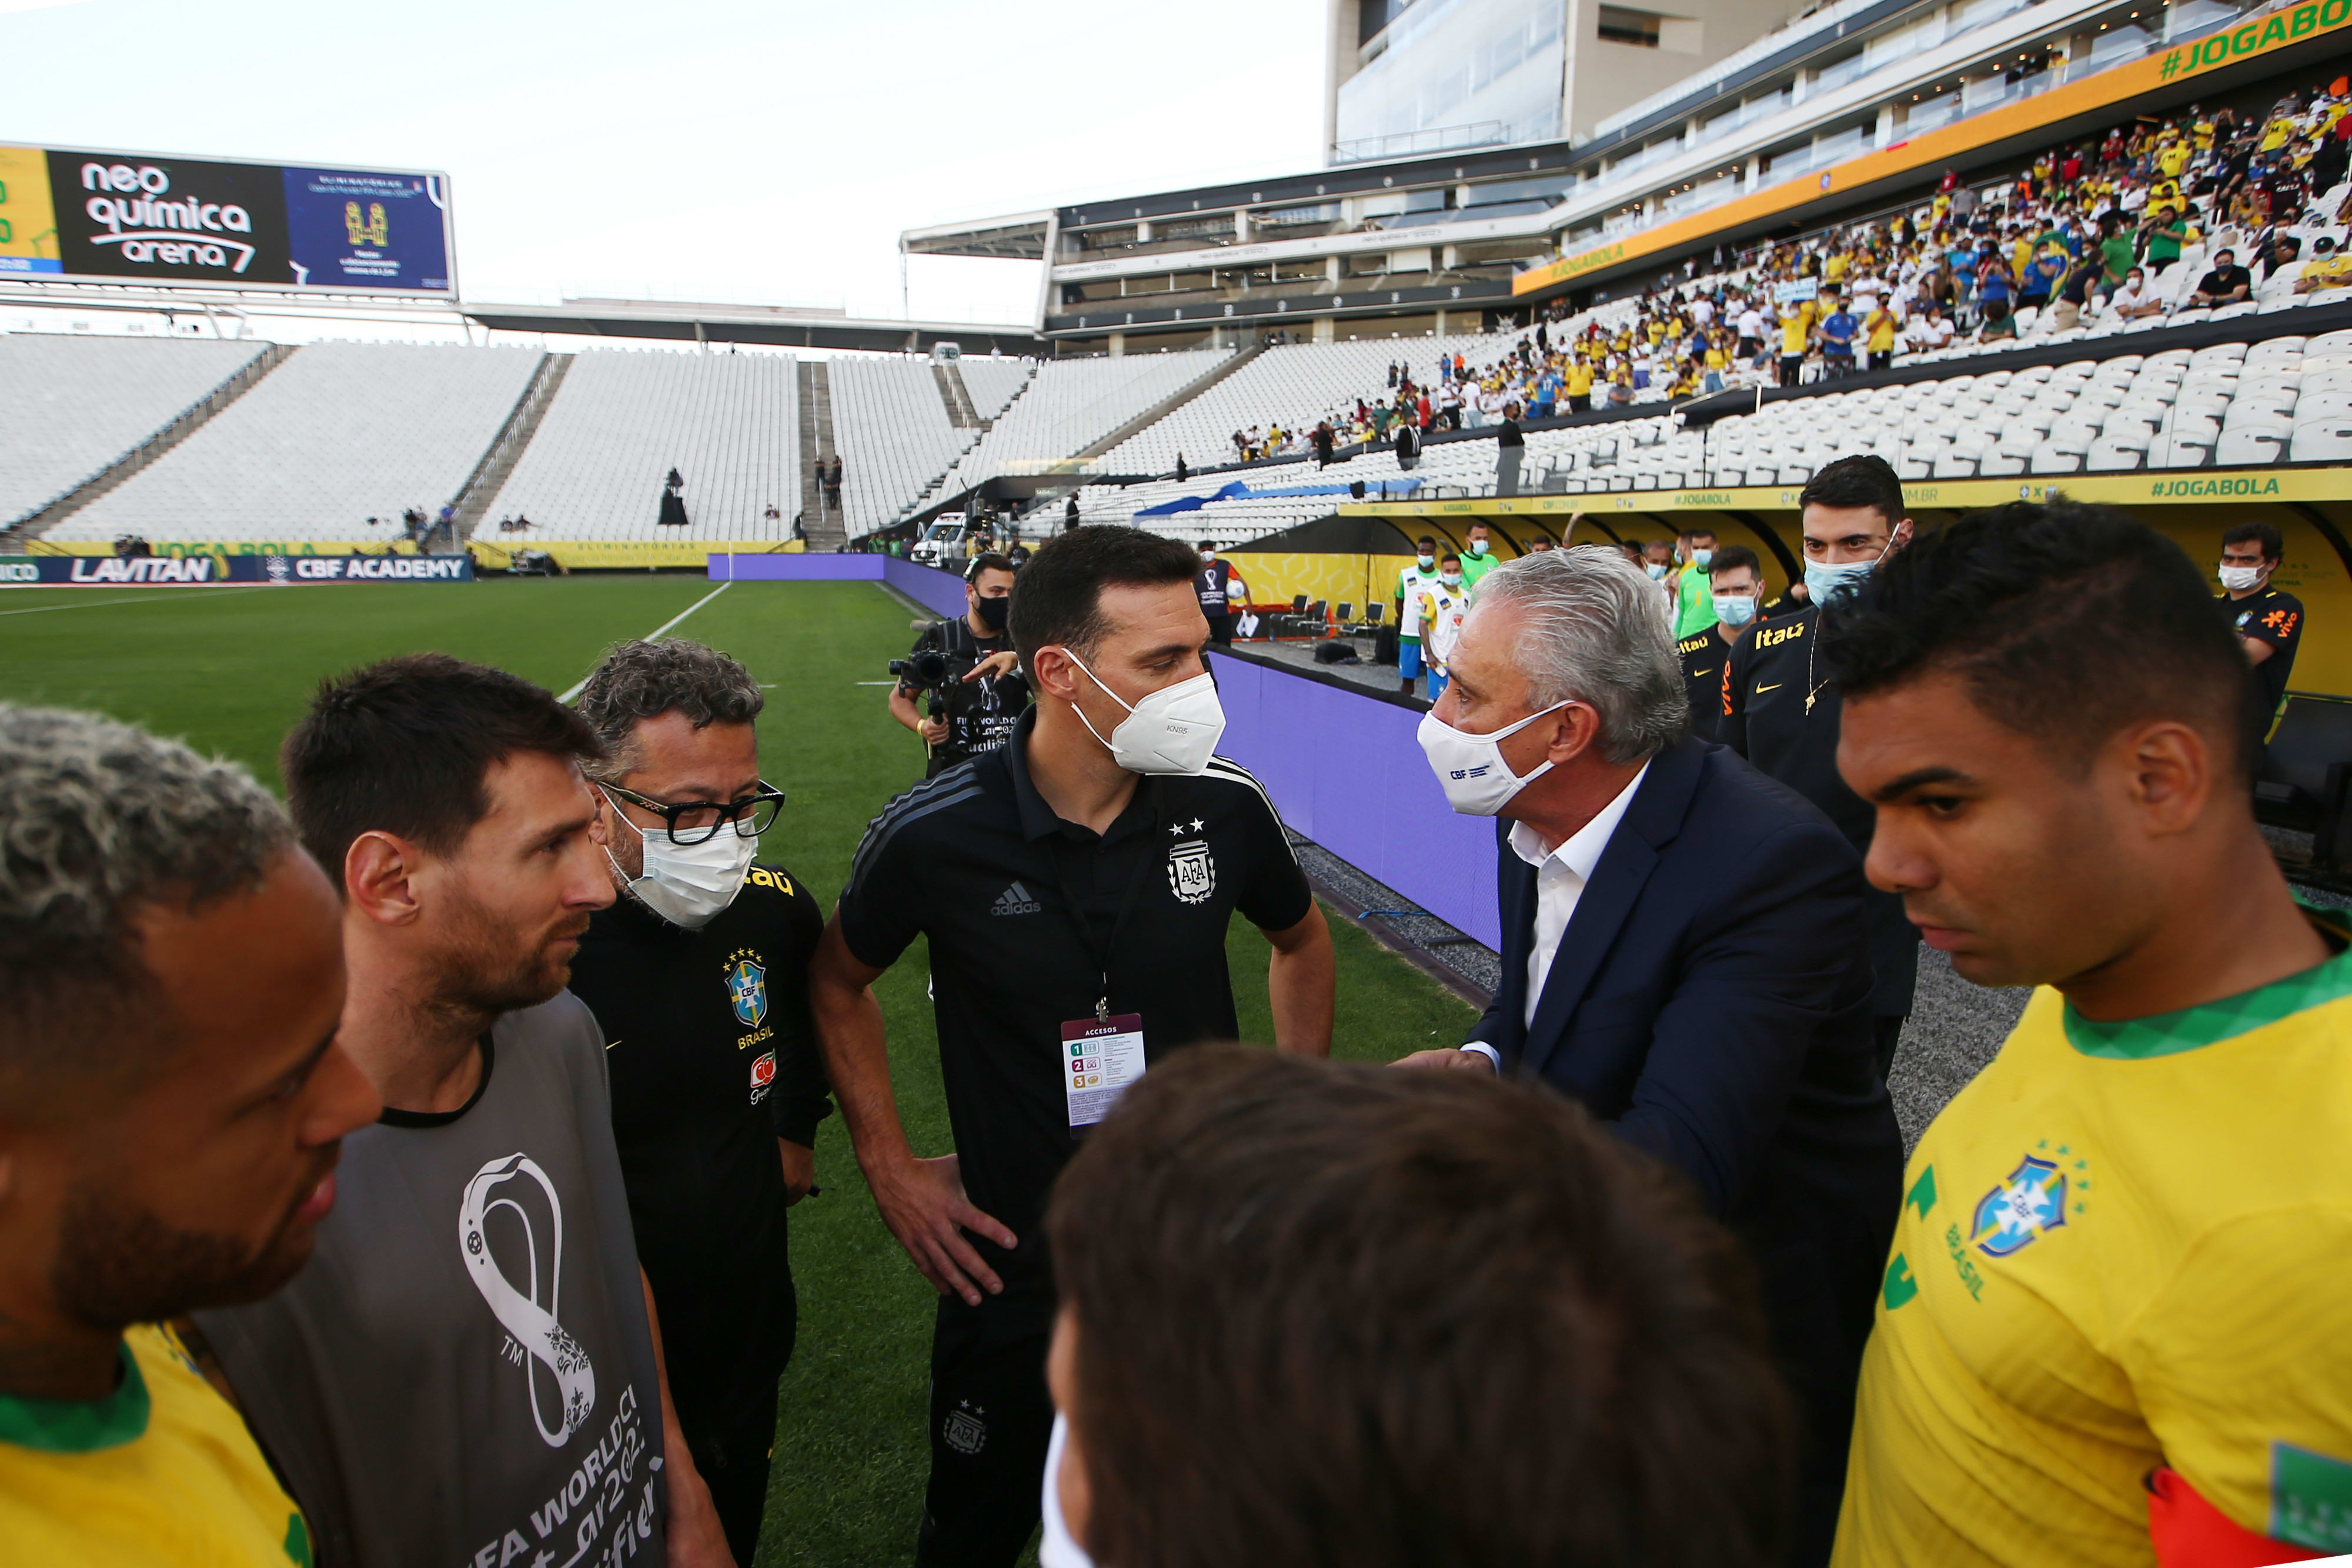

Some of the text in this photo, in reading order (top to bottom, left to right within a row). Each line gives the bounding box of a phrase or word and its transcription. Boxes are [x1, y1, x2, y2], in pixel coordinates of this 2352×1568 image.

[81, 162, 170, 195] neo
[86, 192, 252, 233] química
[121, 240, 227, 267] arena
[1675, 493, 1731, 505] #JOGABOLA
[2151, 477, 2280, 497] #JOGABOLA
[70, 558, 211, 583] LAVITAN
[296, 558, 344, 579] CBF
[346, 558, 465, 580] ACADEMY
[1755, 621, 1805, 650] Itaú
[2277, 612, 2298, 638] vivo
[1679, 636, 1709, 654] Itaú
[1167, 725, 1188, 734] KN95
[1450, 769, 1466, 780] CBF
[744, 866, 794, 897] aú
[1181, 857, 1207, 886] AFA
[991, 901, 1041, 917] adidas
[741, 985, 756, 998] CBF
[737, 1026, 774, 1051] BRASIL
[1085, 1027, 1117, 1037] ACCESOS
[1074, 1045, 1080, 1055] 1
[1074, 1061, 1083, 1071] 2
[1076, 1078, 1084, 1087] 3
[1945, 1223, 1984, 1303] BRASIL
[500, 1335, 524, 1367] TM
[530, 1414, 622, 1539] WORLD
